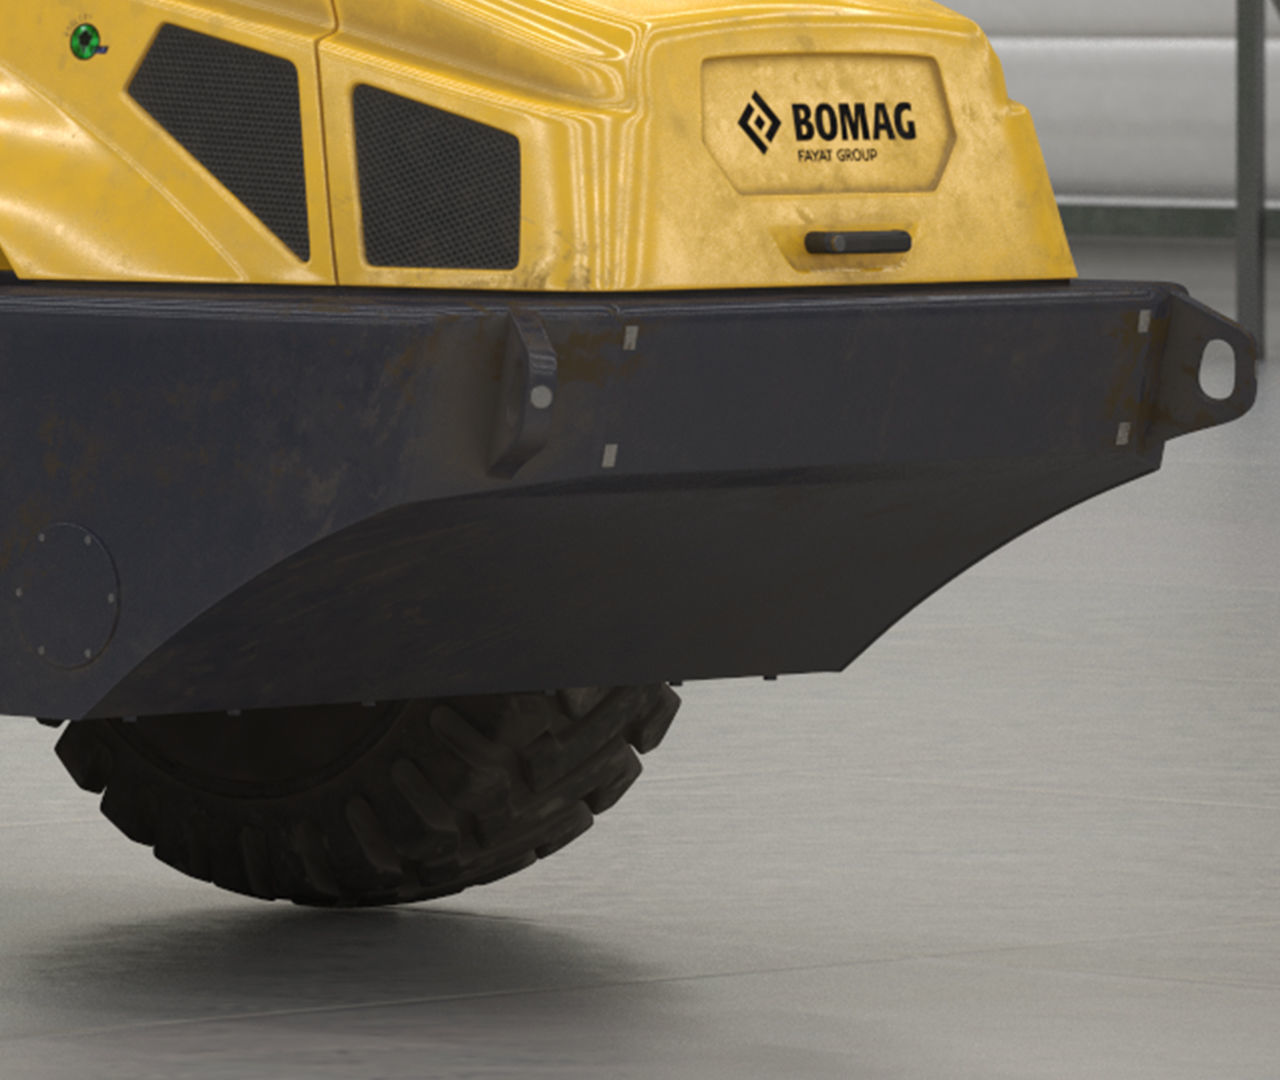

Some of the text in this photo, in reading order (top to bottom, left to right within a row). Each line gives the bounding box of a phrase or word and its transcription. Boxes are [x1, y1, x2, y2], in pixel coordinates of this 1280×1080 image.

[791, 102, 916, 142] BOMAG
[797, 148, 877, 163] FAYAT GROUP
